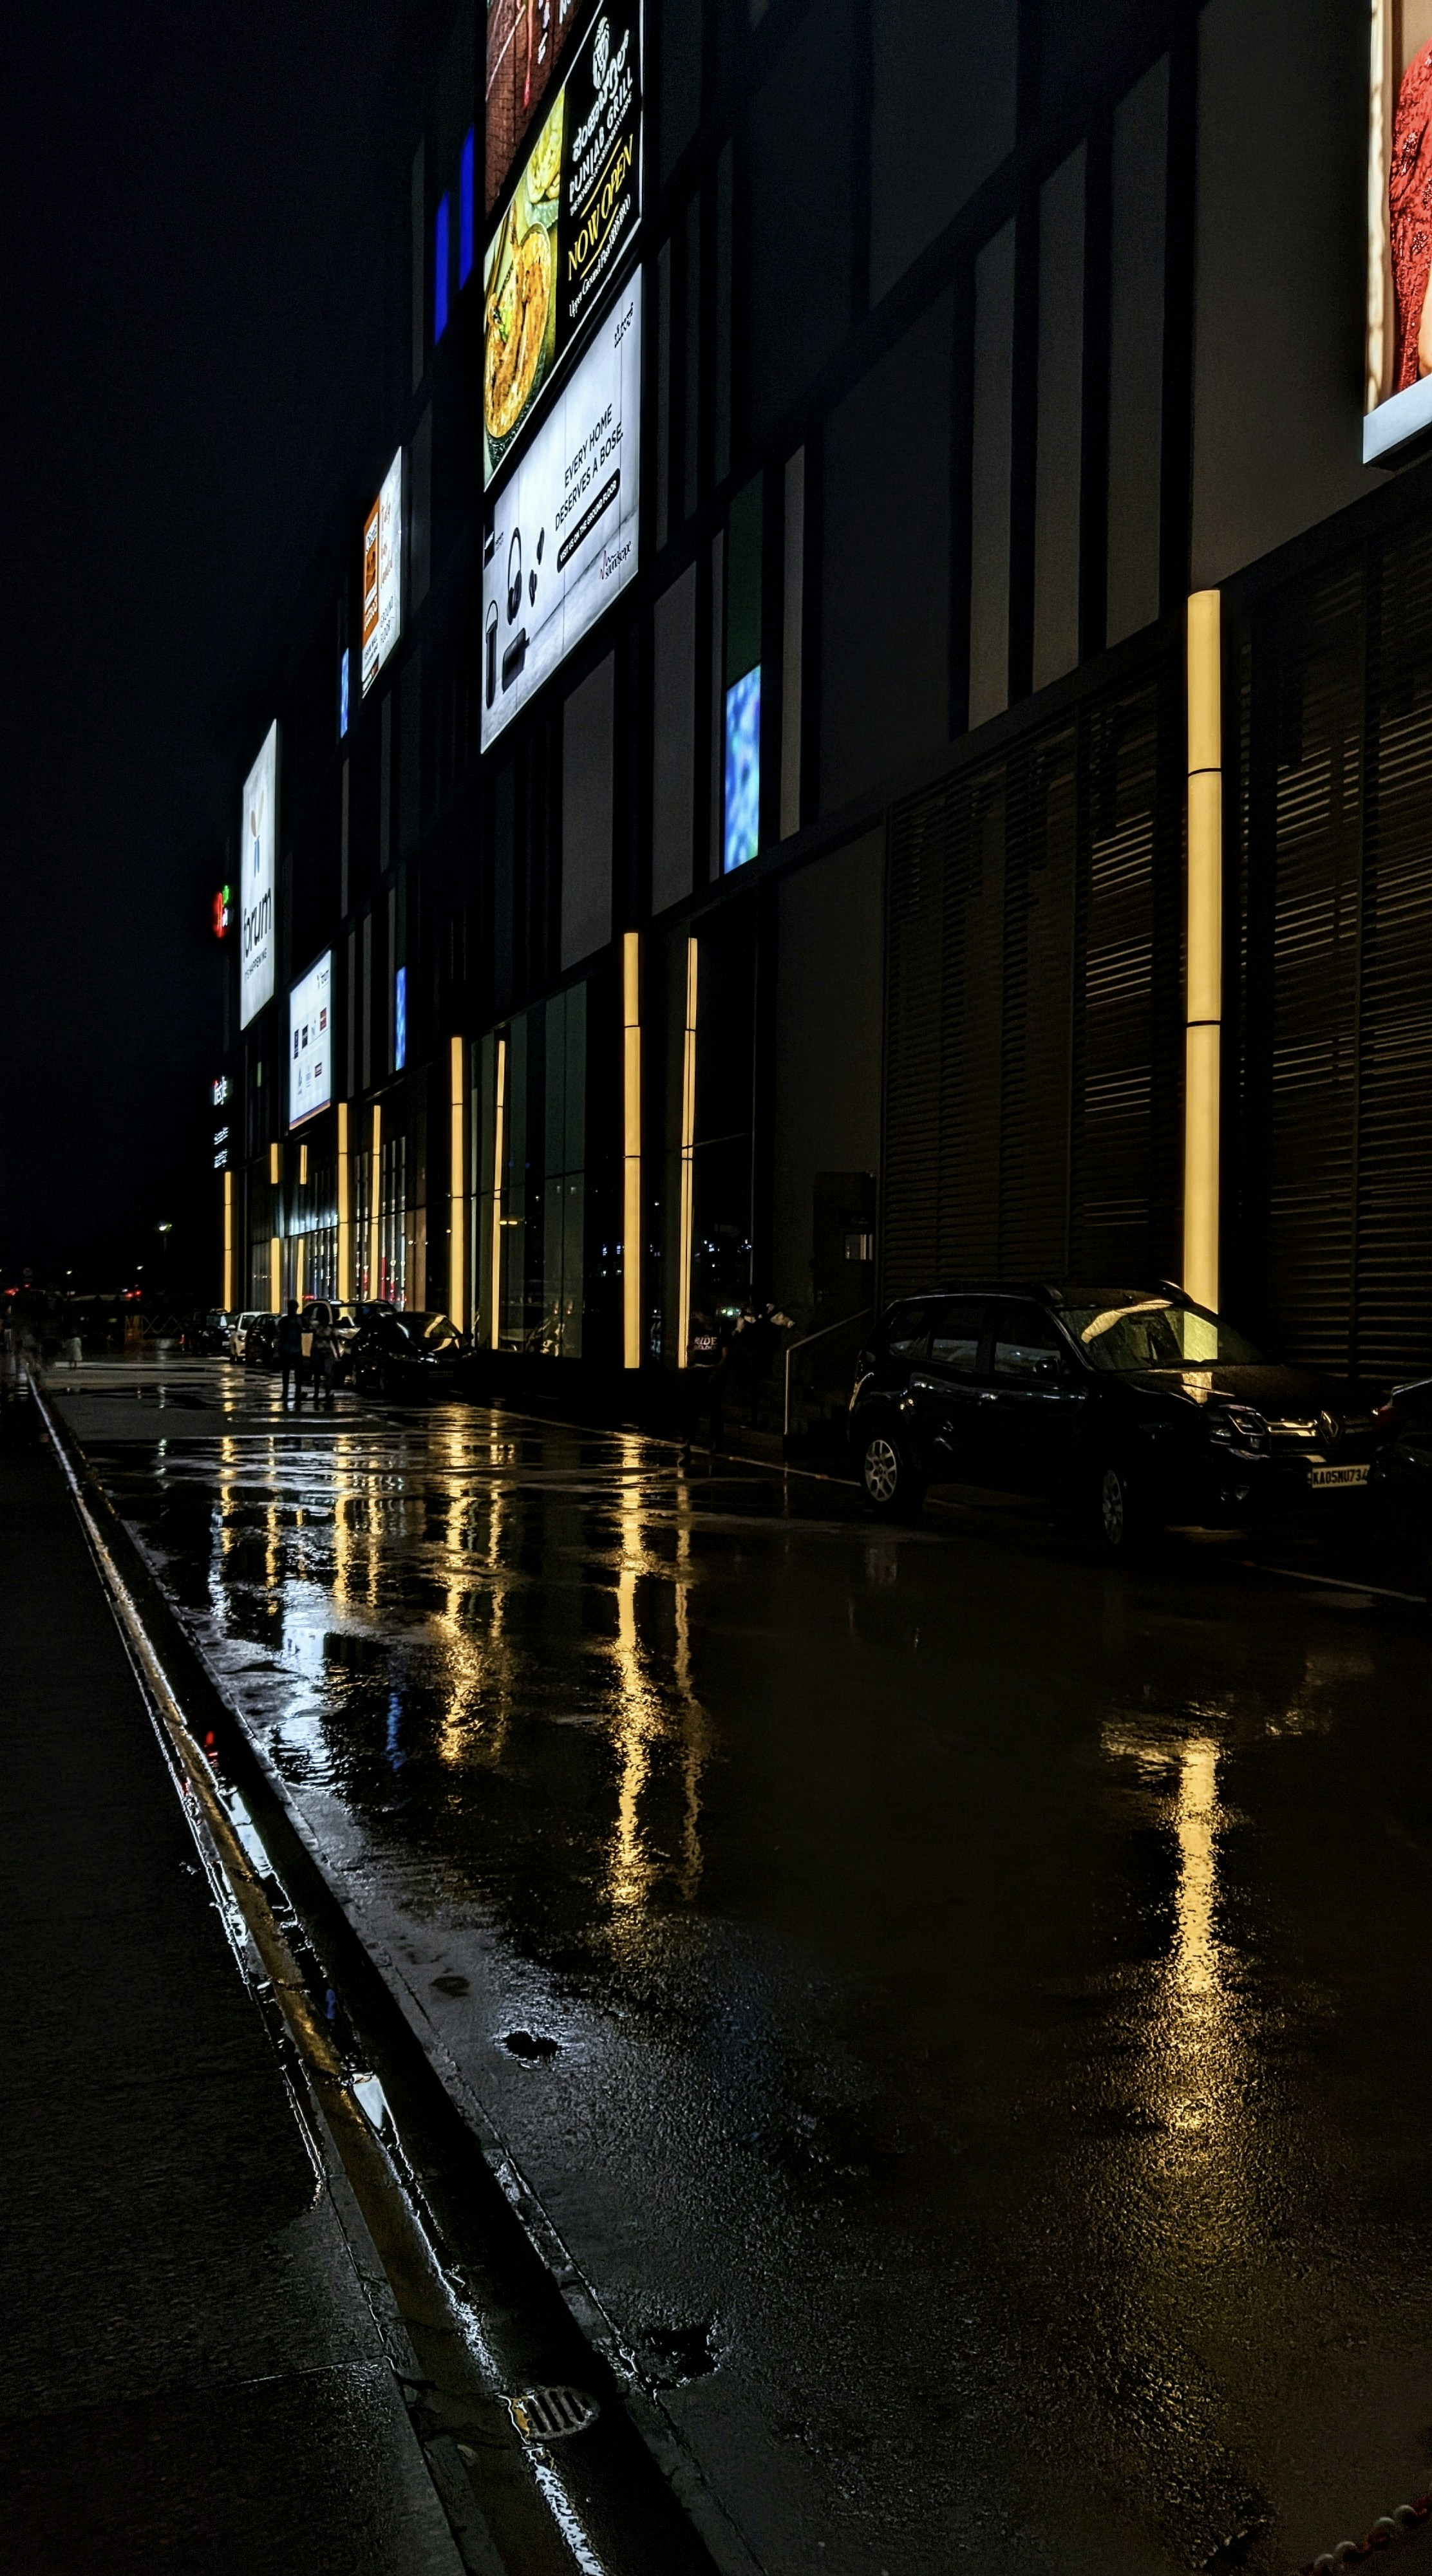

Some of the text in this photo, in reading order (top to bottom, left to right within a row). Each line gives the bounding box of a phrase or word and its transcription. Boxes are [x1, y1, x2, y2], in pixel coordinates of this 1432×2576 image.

[569, 126, 604, 202] PUNJAB
[607, 66, 633, 129] GRILL
[569, 203, 600, 281] NOW
[601, 133, 633, 220] OPEN
[555, 421, 623, 532] DESERVES A BOSE.
[565, 403, 612, 488] EVERY HOME
[587, 498, 603, 525] GROUND
[603, 480, 617, 504] FLOOR
[243, 887, 272, 963] forum
